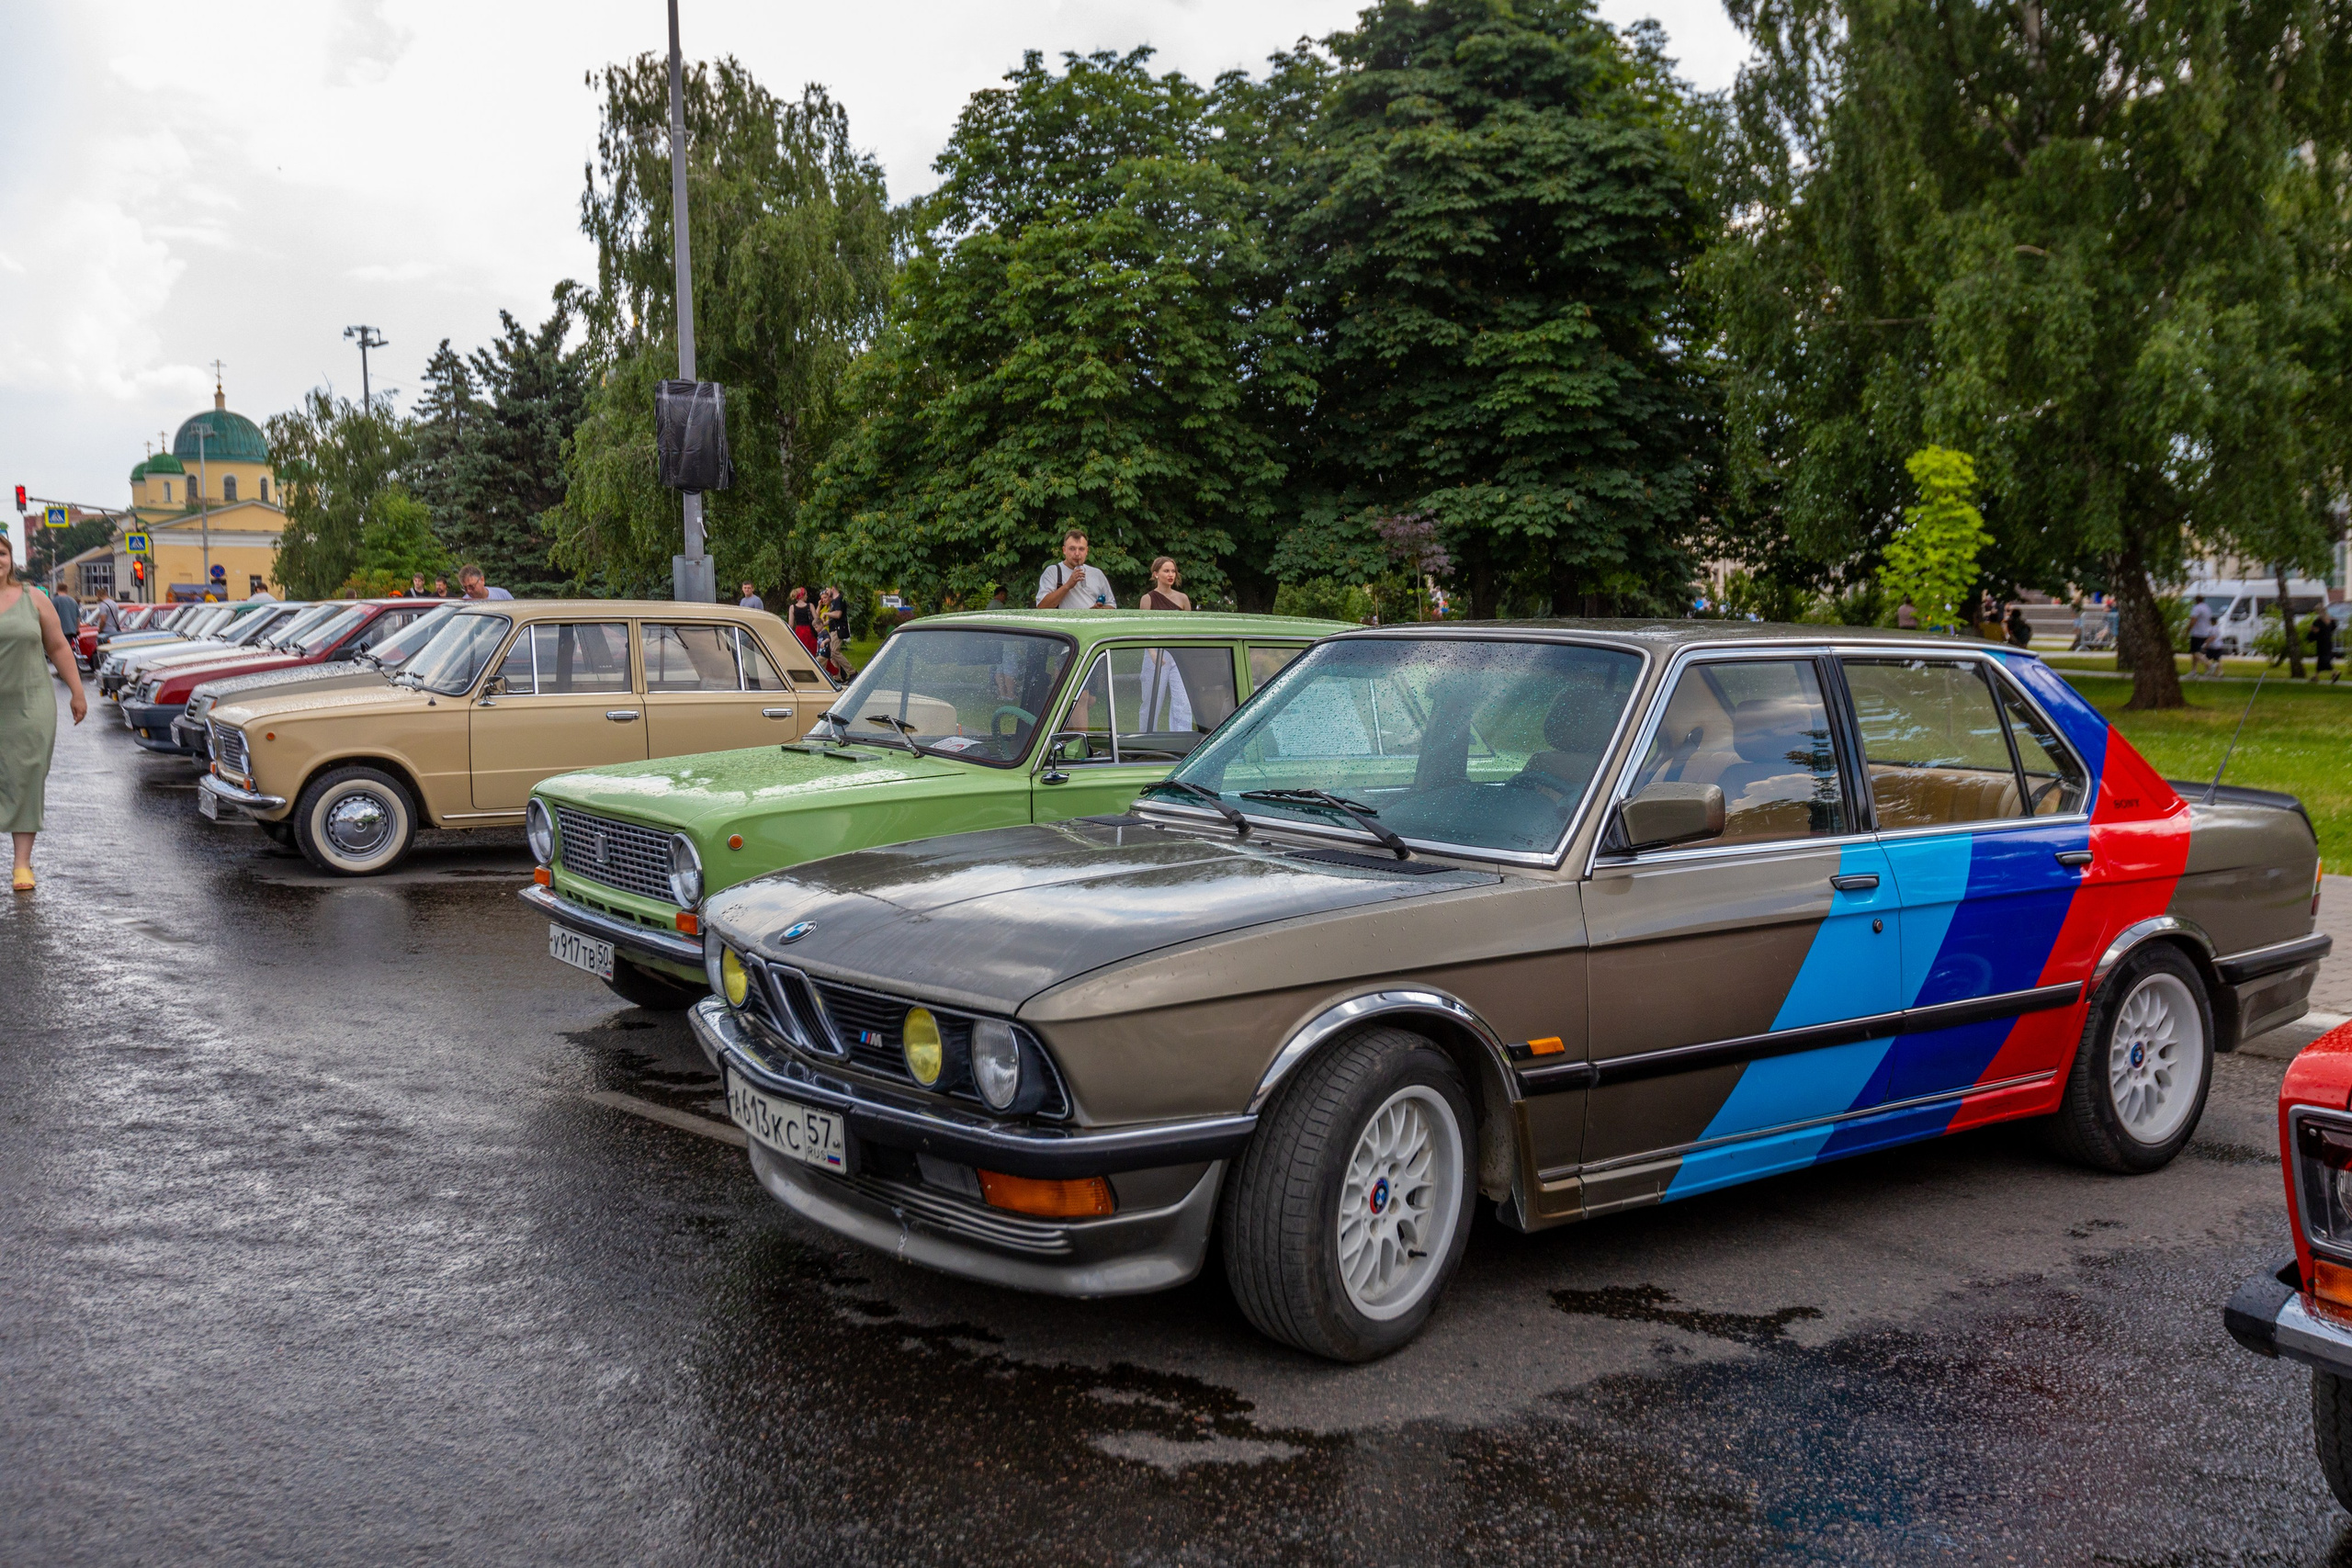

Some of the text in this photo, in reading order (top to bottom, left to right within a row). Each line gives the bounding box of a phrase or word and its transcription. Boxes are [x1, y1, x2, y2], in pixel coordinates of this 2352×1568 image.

[597, 943, 609, 967] 50
[806, 1113, 831, 1148] 57
[806, 1145, 827, 1162] RUS
